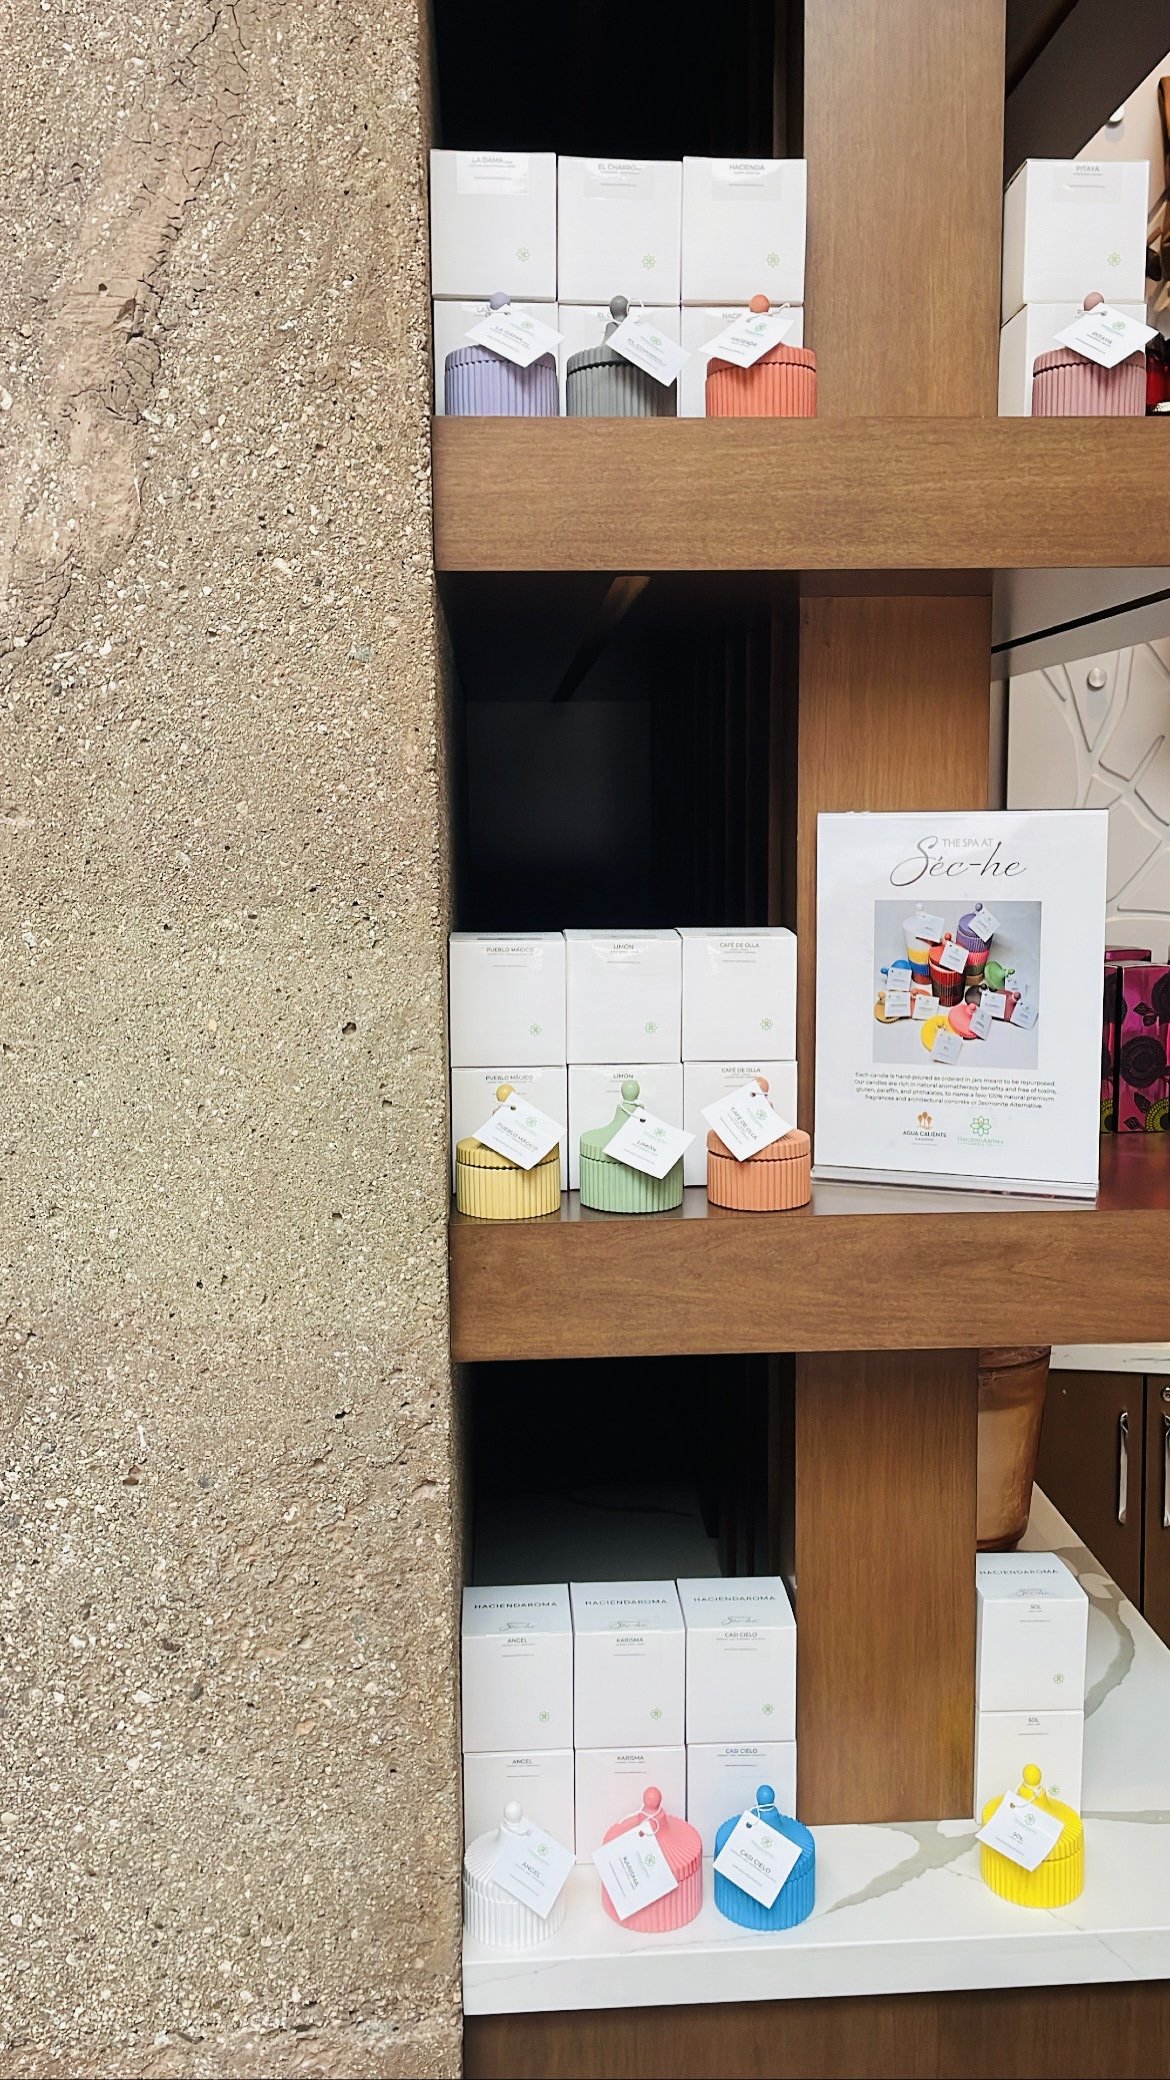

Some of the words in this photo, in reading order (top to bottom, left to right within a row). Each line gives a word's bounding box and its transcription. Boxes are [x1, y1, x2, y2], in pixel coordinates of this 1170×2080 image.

[942, 838, 961, 848] THE
[962, 838, 980, 848] SPA
[981, 838, 994, 848] AT
[1012, 1831, 1023, 1841] SOL
[522, 1861, 541, 1878] ANGEL
[740, 1849, 754, 1862] CASI
[752, 1858, 772, 1874] CIELO
[622, 1856, 640, 1887] KARISMA
